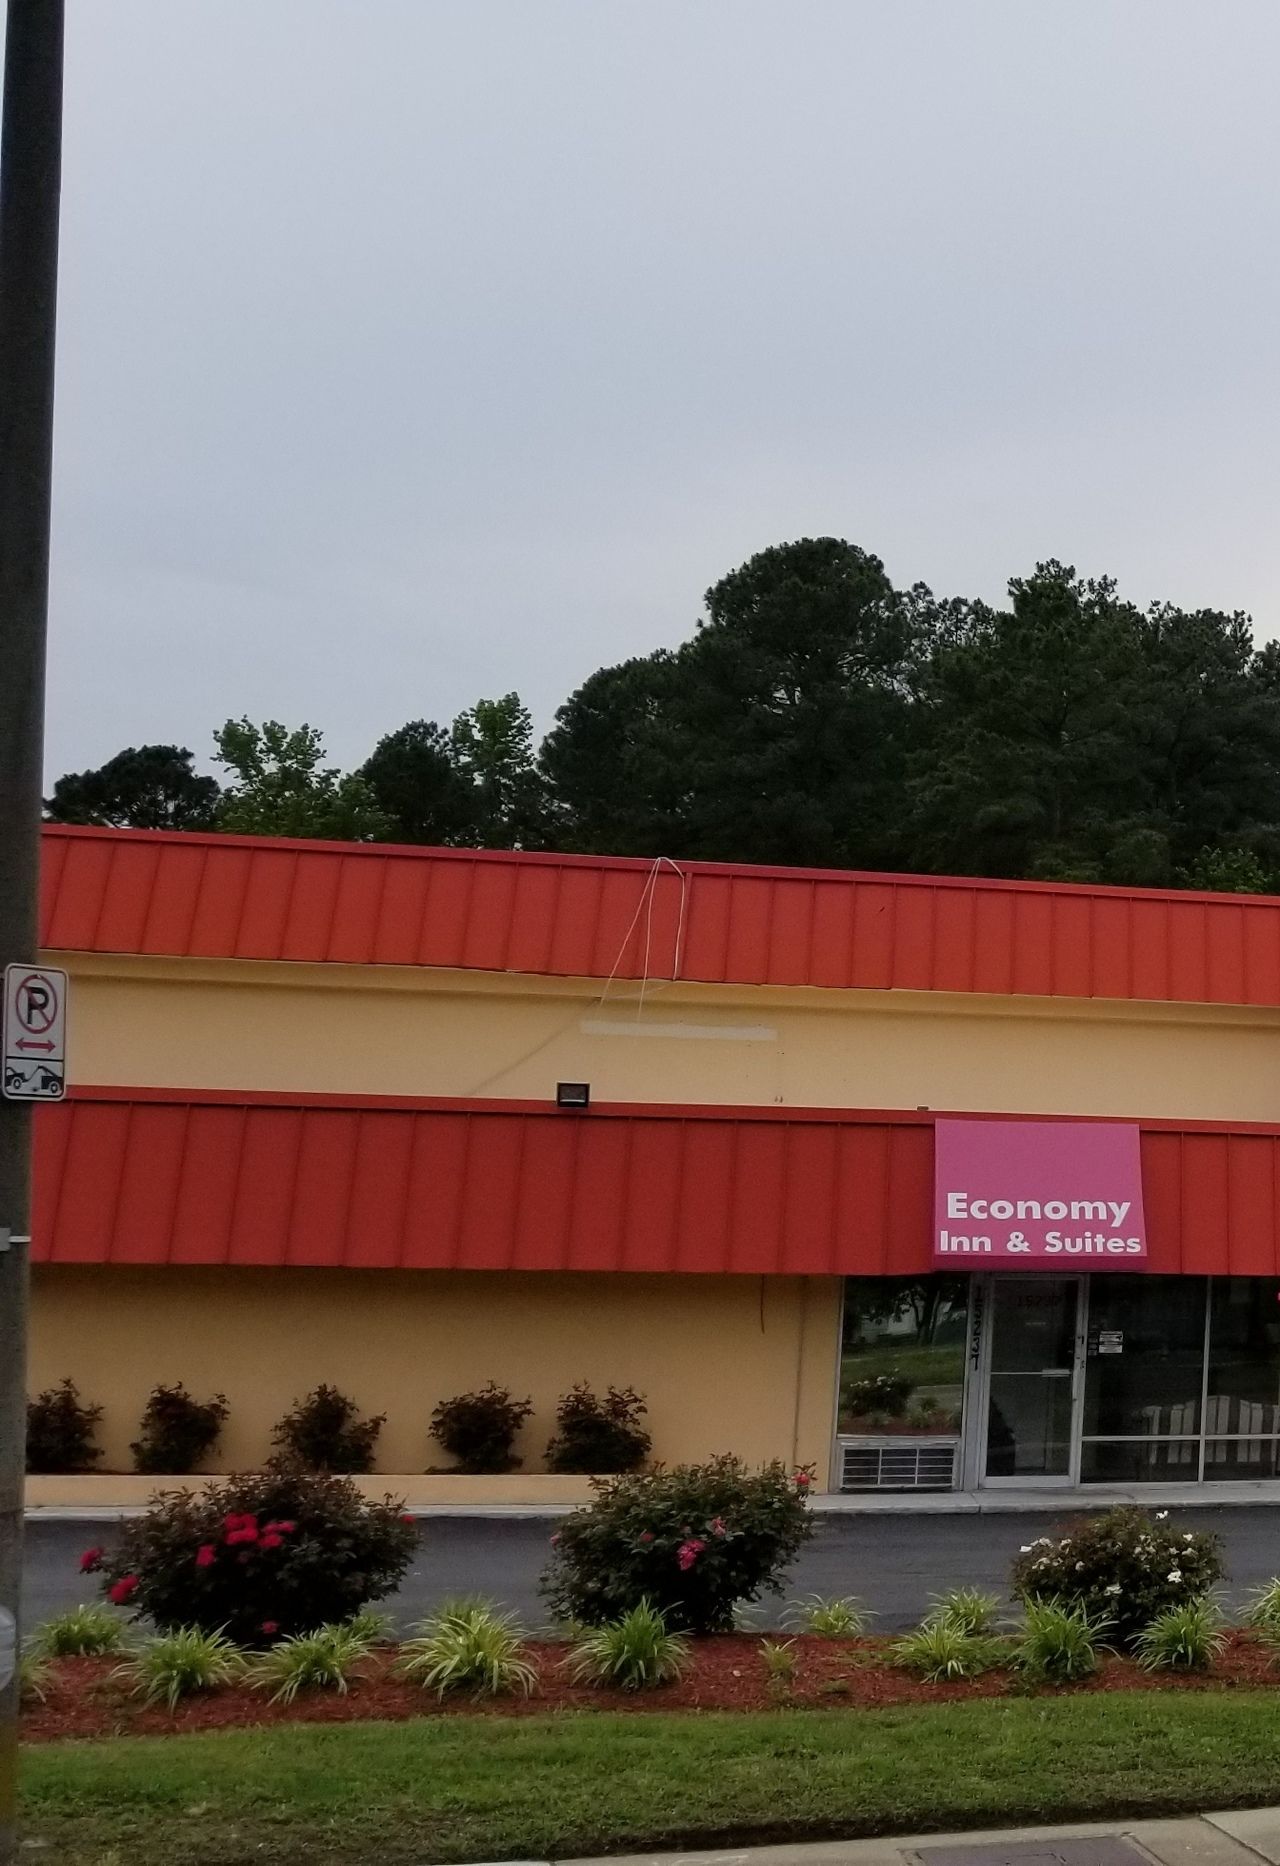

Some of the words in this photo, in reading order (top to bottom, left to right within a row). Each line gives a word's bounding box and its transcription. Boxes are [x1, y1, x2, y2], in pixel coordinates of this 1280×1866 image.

[947, 1192, 1131, 1227] Economy
[940, 1230, 992, 1252] Inn
[1006, 1231, 1031, 1253] &
[1044, 1231, 1141, 1253] Suites
